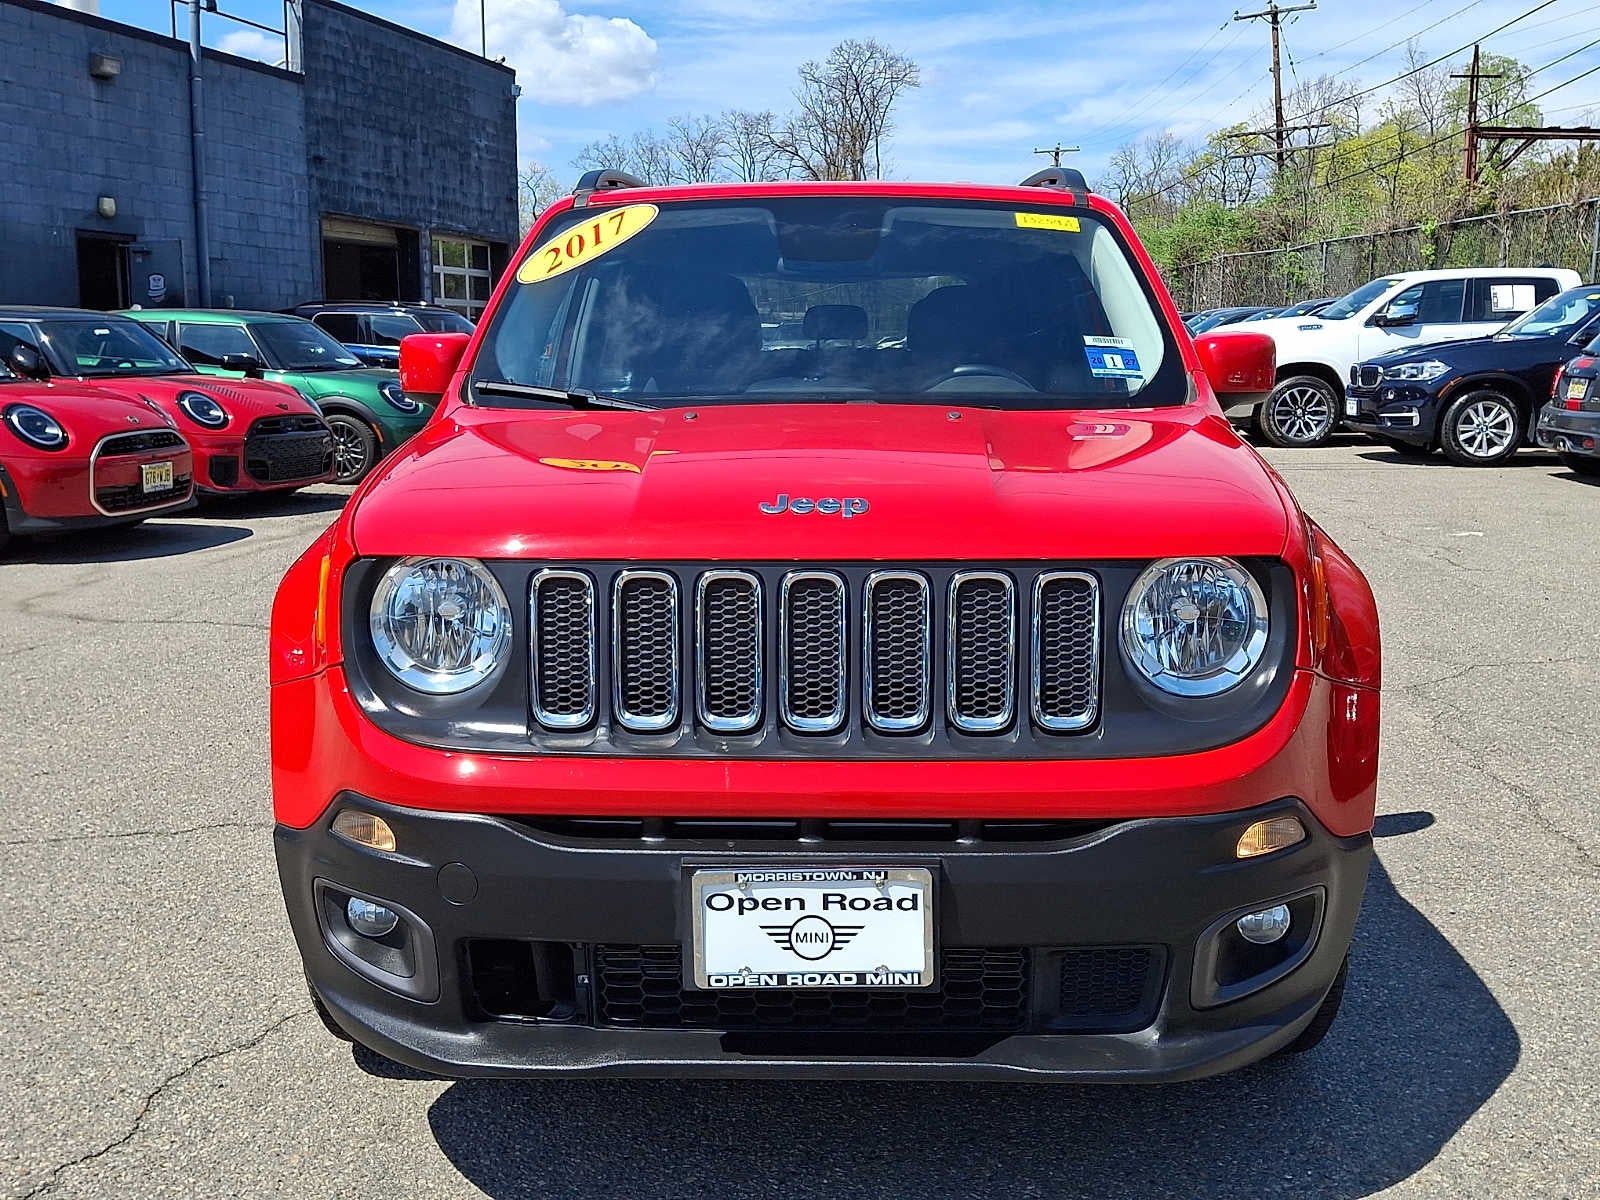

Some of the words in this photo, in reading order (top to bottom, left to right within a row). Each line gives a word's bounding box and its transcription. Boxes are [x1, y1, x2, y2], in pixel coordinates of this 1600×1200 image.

[544, 211, 626, 273] 2017
[1109, 356, 1118, 368] 1
[1124, 358, 1136, 367] 27
[759, 493, 870, 519] Jeep
[863, 871, 885, 881] NJ
[705, 892, 806, 916] Open
[822, 893, 919, 911] Road
[795, 931, 829, 944] MINI
[709, 974, 778, 987] OPEN
[786, 973, 857, 986] ROAD
[865, 973, 919, 985] MINI
